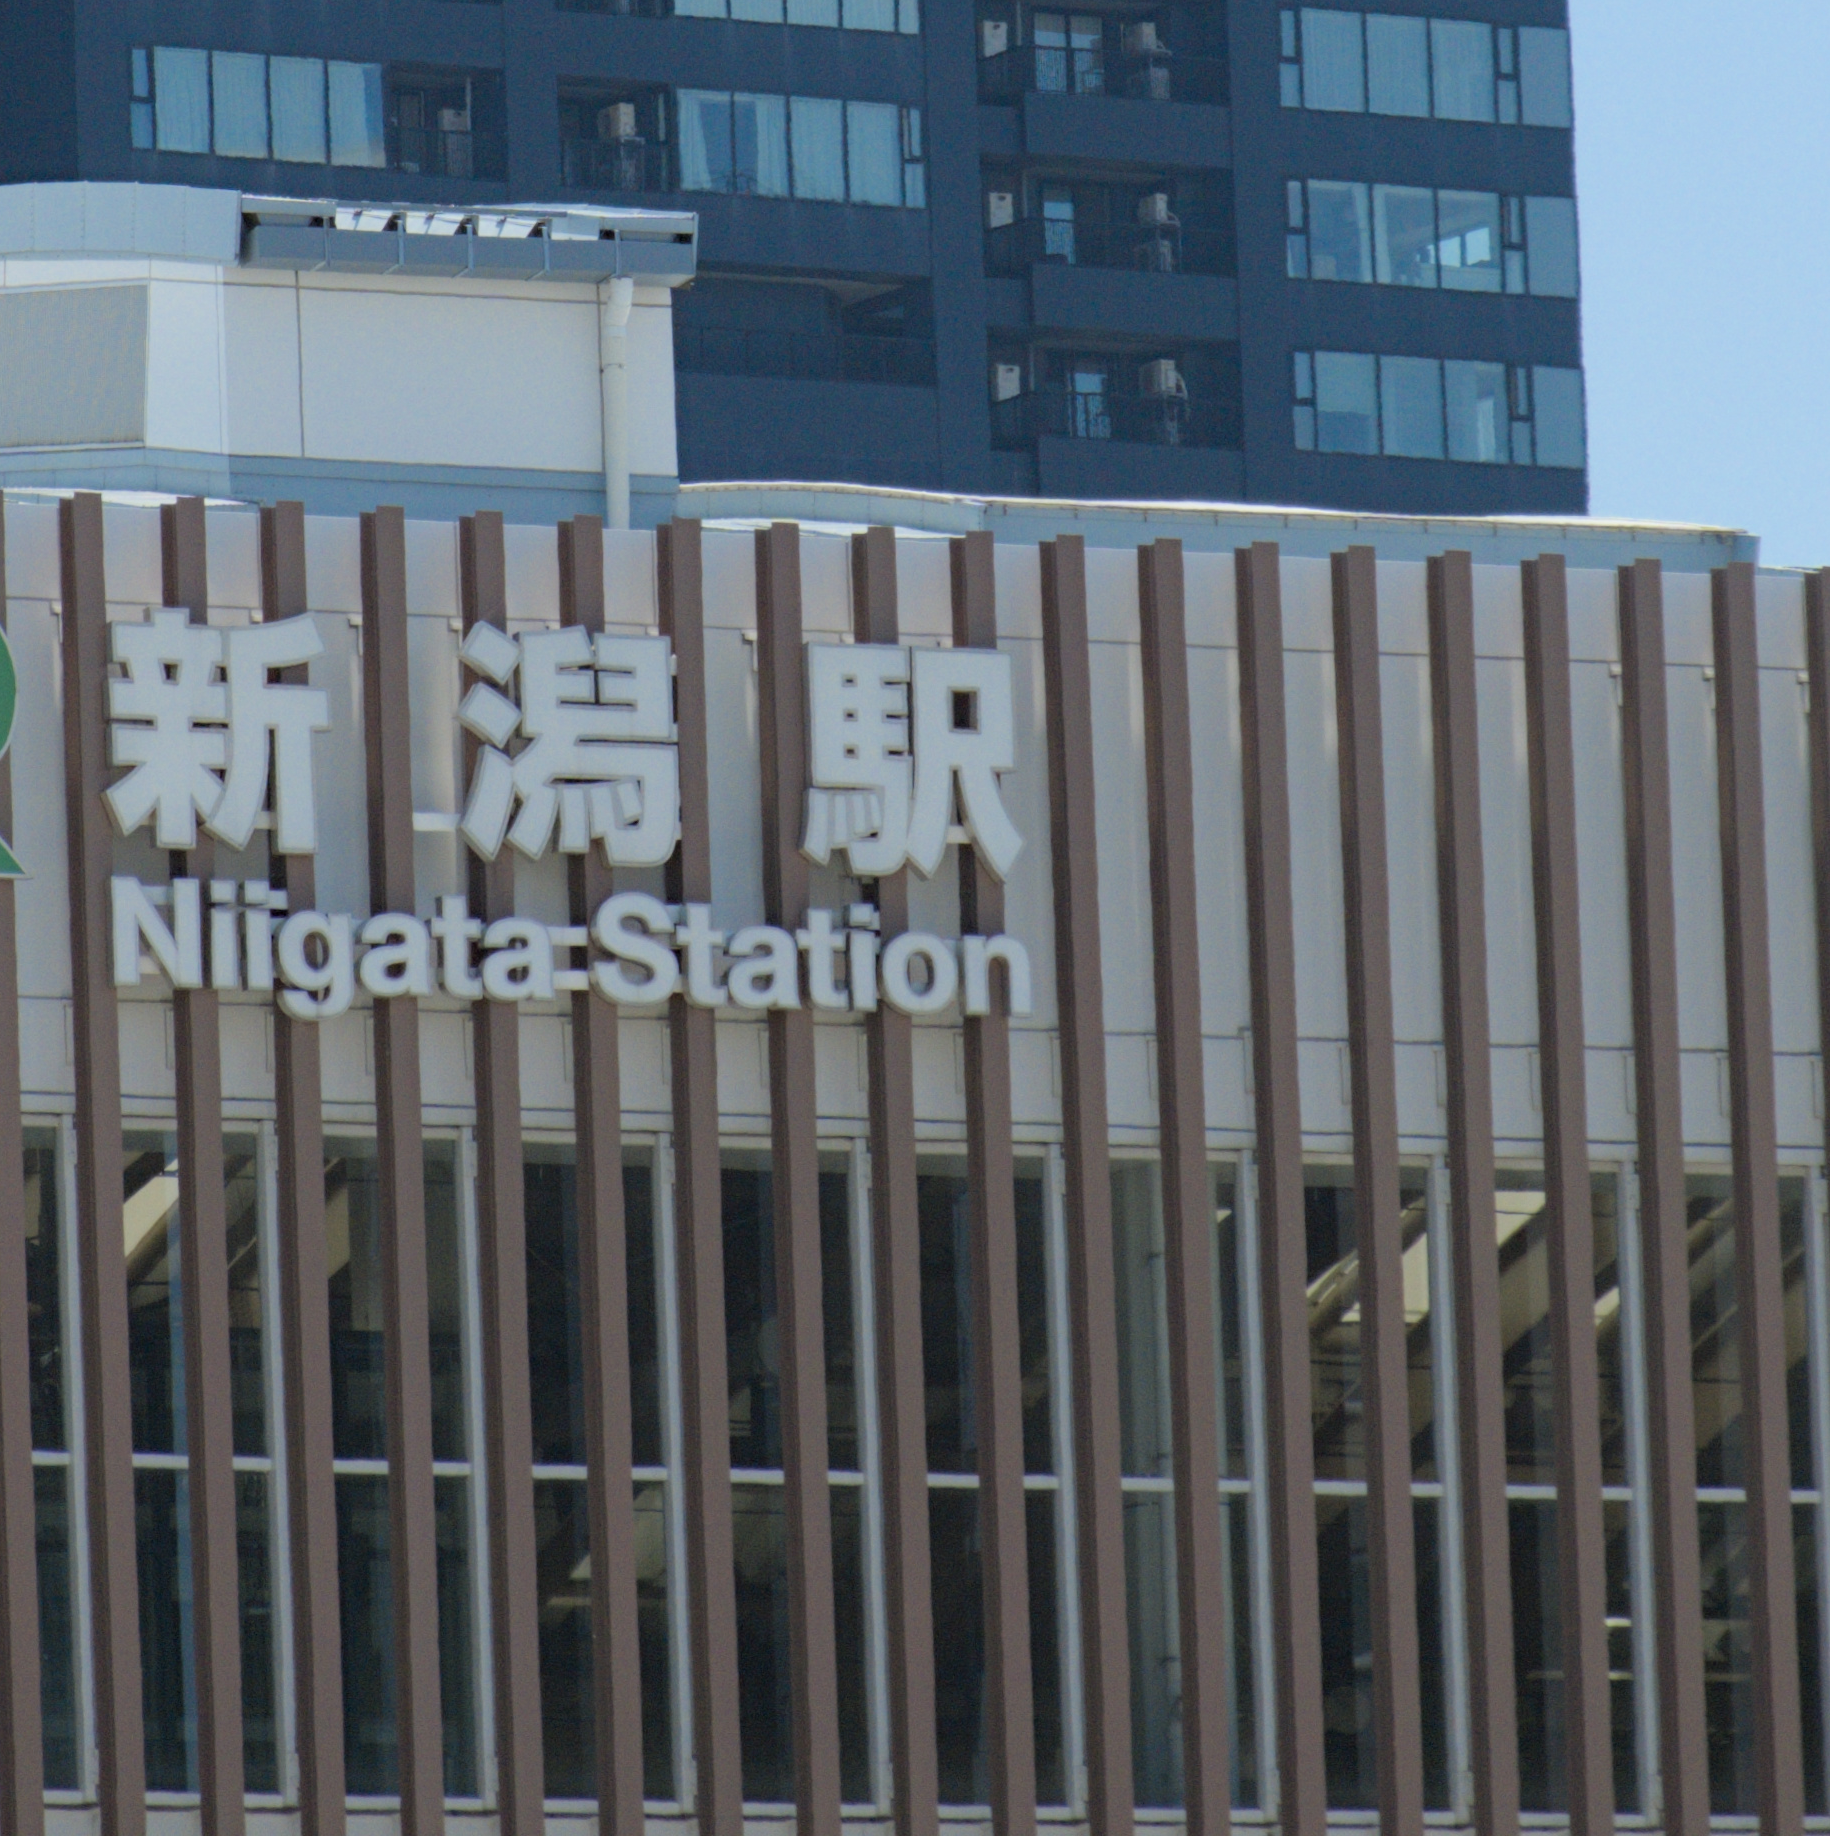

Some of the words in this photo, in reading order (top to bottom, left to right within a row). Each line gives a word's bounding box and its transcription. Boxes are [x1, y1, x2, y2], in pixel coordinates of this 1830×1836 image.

[102, 607, 1025, 882] 新潟駅
[111, 875, 555, 1022] Niigata
[589, 892, 1031, 1018] Station
